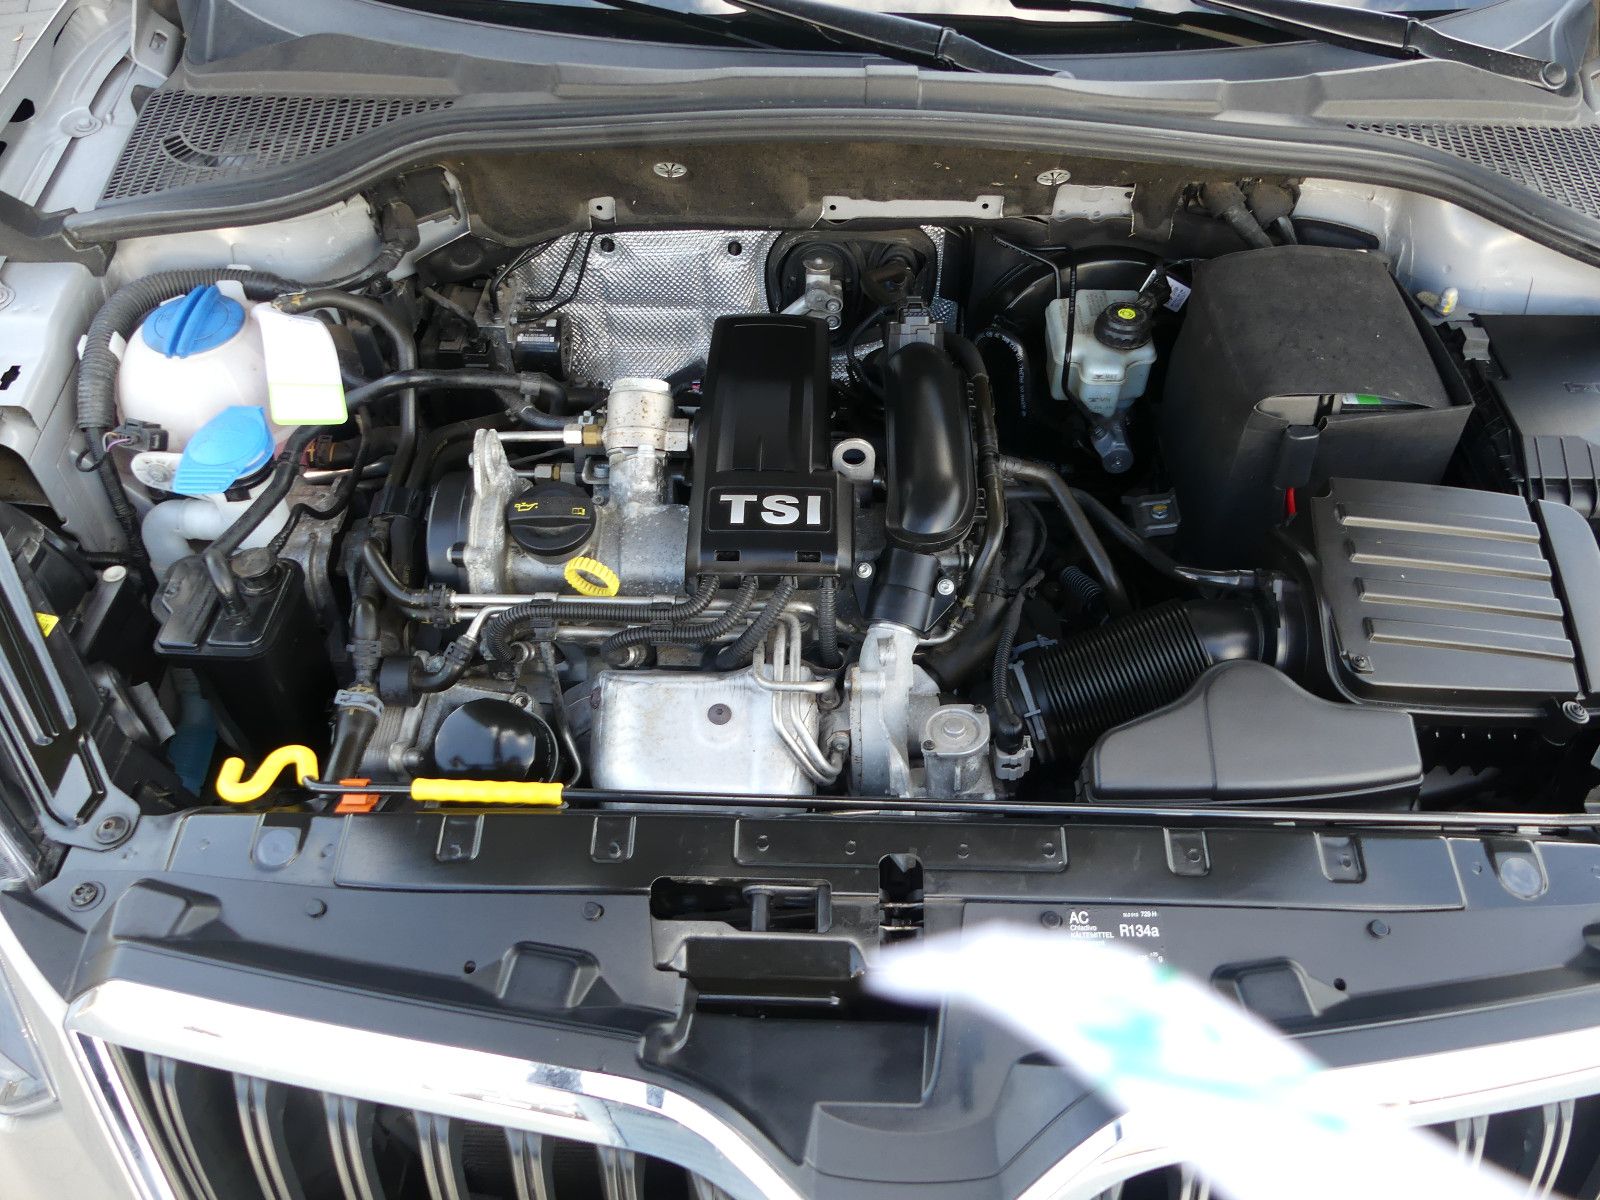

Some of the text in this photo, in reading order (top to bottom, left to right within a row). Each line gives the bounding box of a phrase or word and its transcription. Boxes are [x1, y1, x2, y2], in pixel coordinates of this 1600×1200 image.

[719, 494, 822, 525] TSI
[1069, 911, 1089, 924] AC
[1119, 924, 1160, 937] R134a
